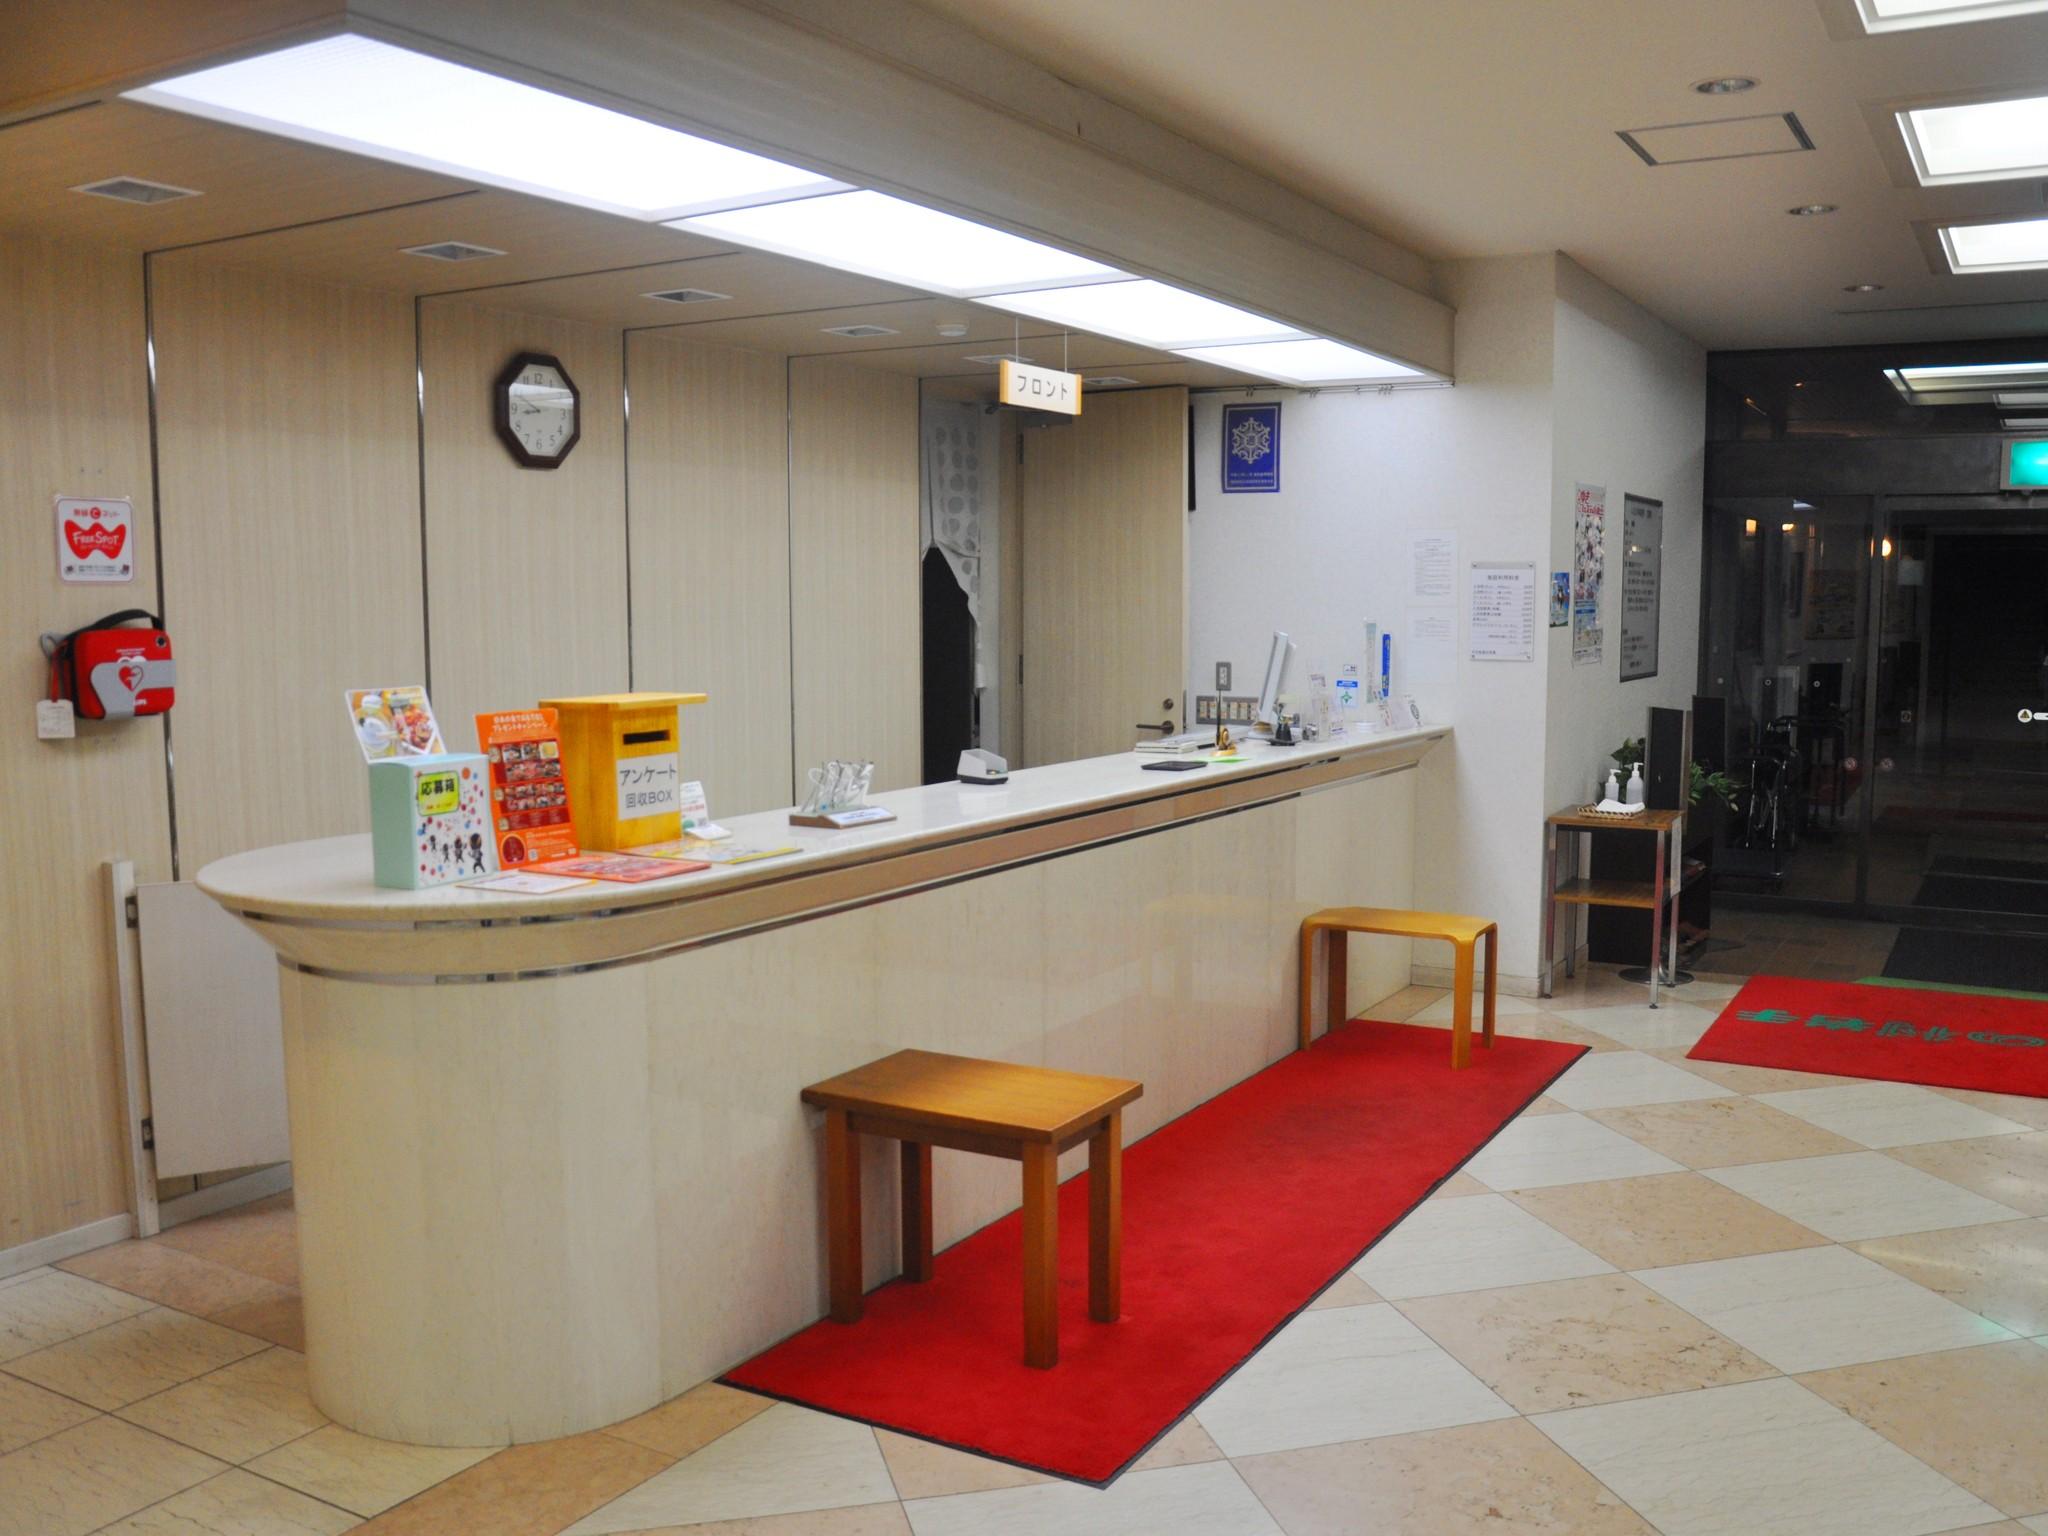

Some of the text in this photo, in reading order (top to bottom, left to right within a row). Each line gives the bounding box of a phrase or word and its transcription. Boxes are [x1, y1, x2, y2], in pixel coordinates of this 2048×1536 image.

[1016, 375, 1068, 401] フロント
[618, 763, 677, 786] アンケート
[420, 778, 455, 796] 応募箱
[625, 790, 673, 809] 回収BOX
